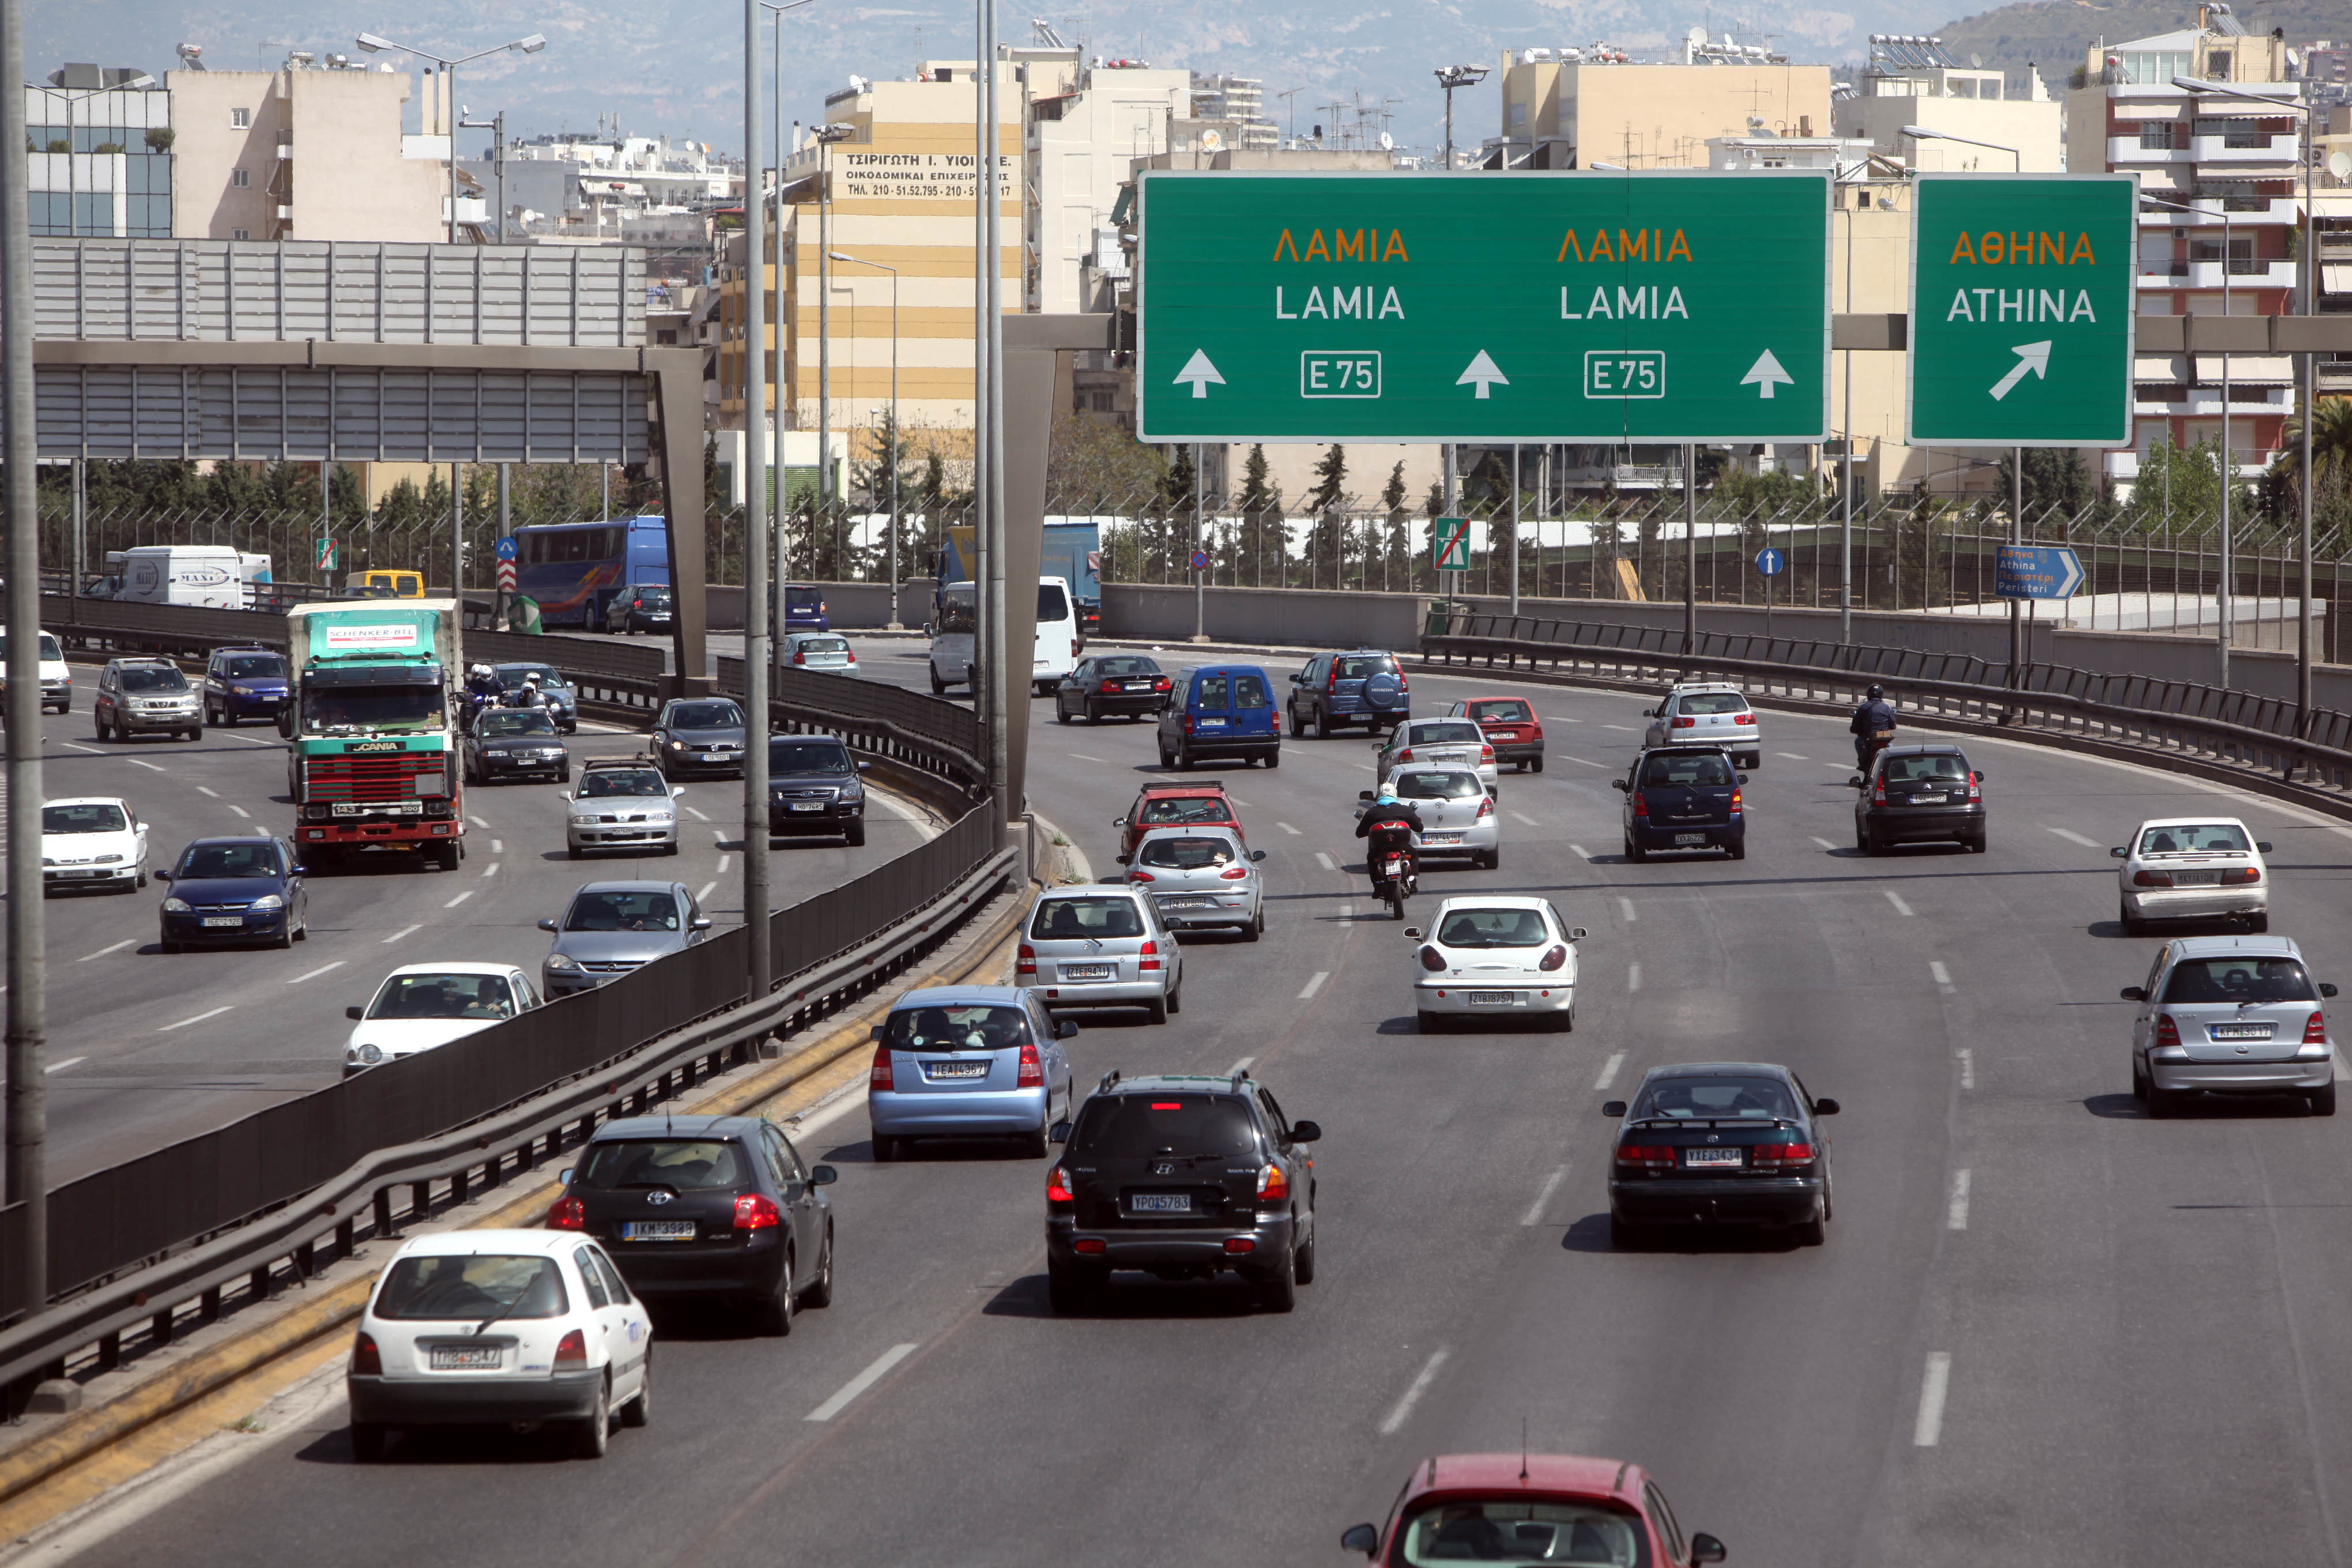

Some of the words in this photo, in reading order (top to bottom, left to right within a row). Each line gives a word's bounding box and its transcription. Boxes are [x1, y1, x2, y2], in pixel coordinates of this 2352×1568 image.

[847, 155, 919, 165] ΤΣΙΡΙΓΩΤΗ
[946, 156, 974, 166] ΥΙΟΙ
[873, 186, 889, 196] 210
[946, 186, 962, 197] 210
[1273, 229, 1408, 262] ΛΑΜΙΑ
[1558, 229, 1693, 262] ΛΑΜΙΑ
[1950, 232, 2095, 265] ΑΘΗΝΑ
[1276, 287, 1405, 319] LAMIA
[1561, 287, 1689, 319] LAMIA
[1947, 289, 2096, 323] ATHINA
[1999, 560, 2036, 570] Athina
[1998, 581, 2047, 593] Peristeri
[330, 629, 415, 637] SCHENKER-BTL
